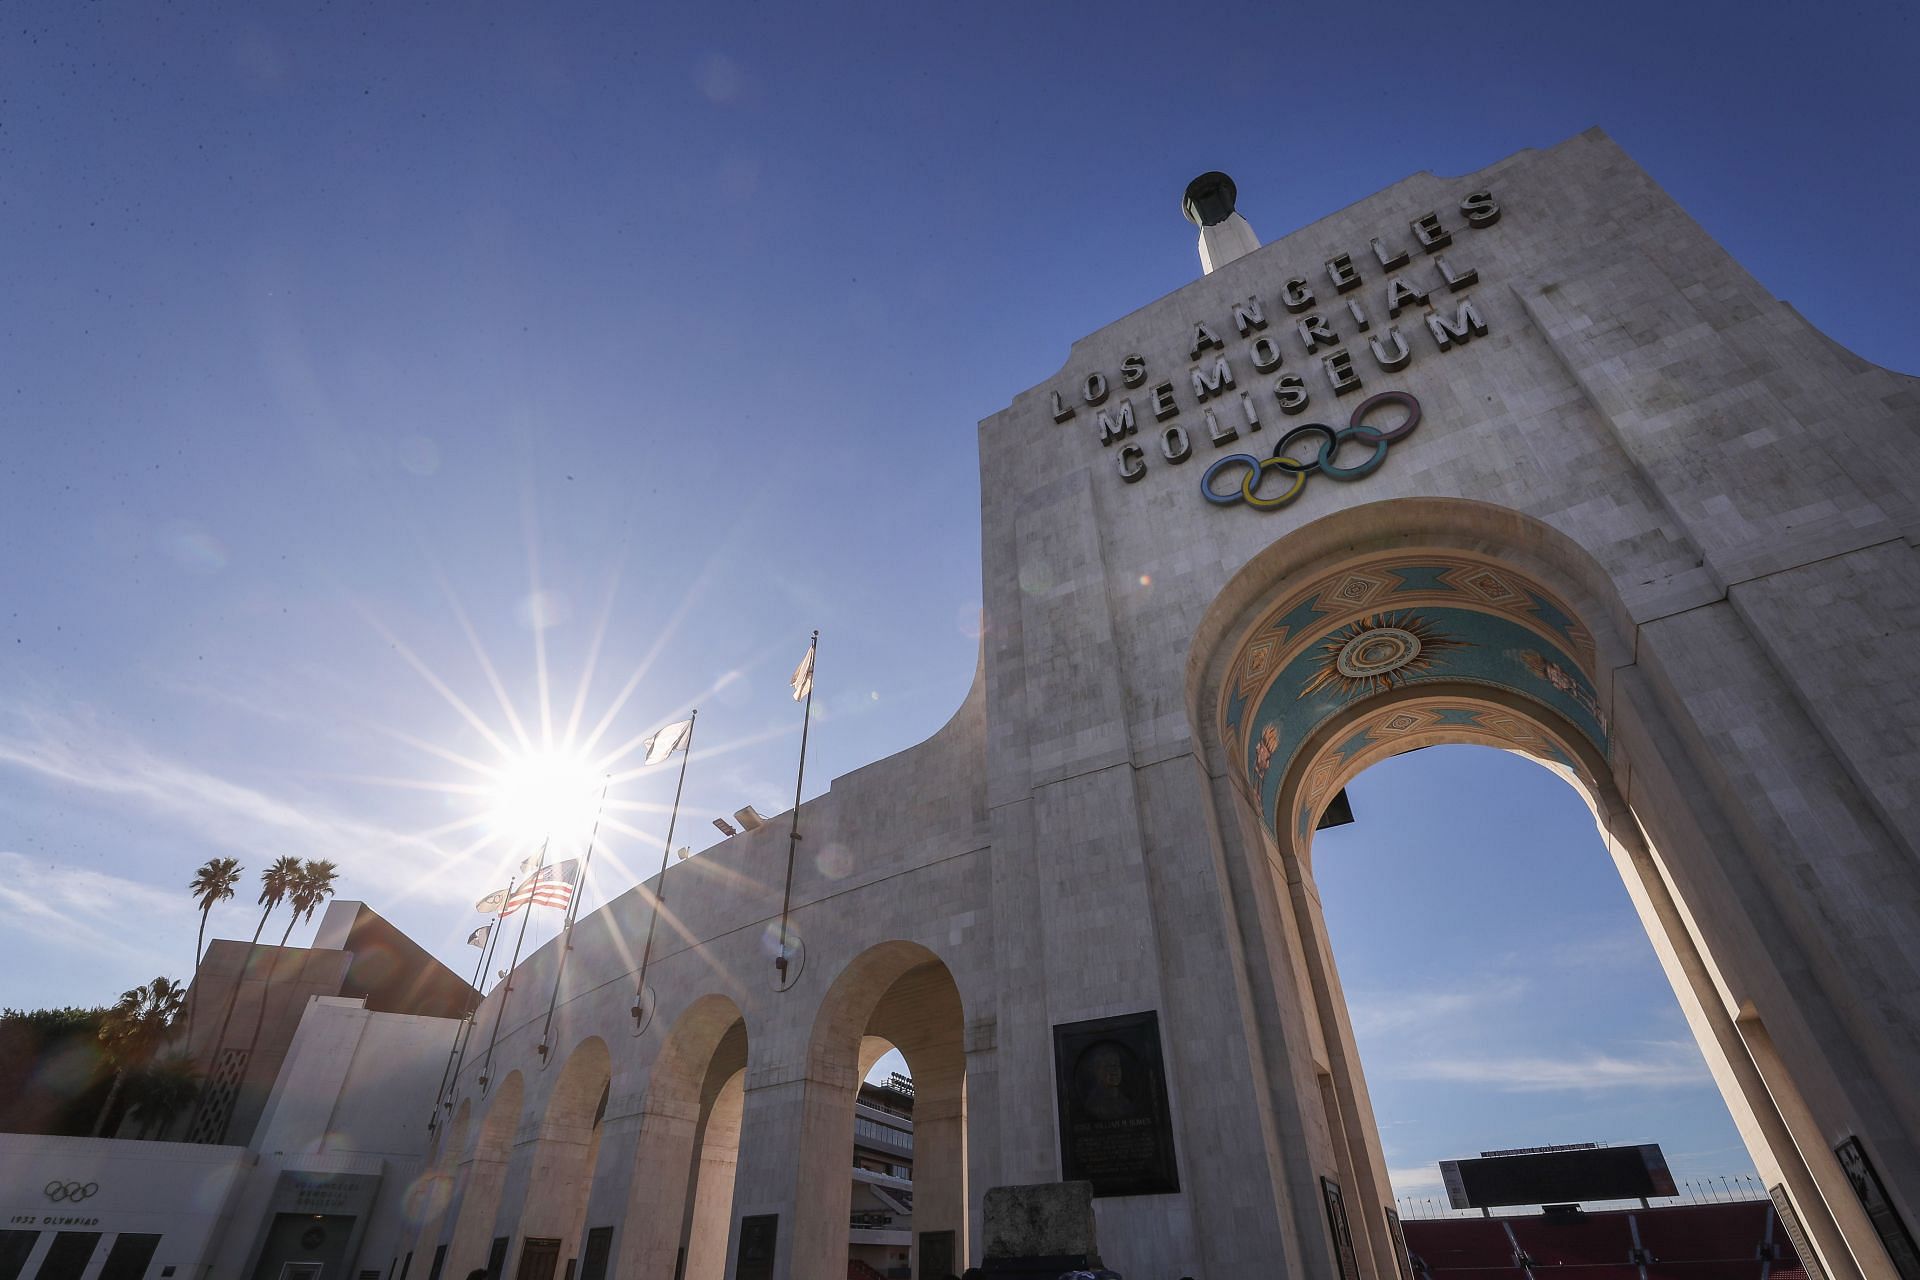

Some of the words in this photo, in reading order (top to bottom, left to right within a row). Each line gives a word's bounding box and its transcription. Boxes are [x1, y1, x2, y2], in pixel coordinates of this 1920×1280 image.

[1050, 353, 1148, 424] LOS
[1189, 190, 1501, 361] ANGELES
[1097, 255, 1479, 446] MEMORIAL
[1116, 297, 1489, 484] COLISEUM
[10, 1215, 37, 1225] 1932
[43, 1216, 99, 1226] OLYMPIAD
